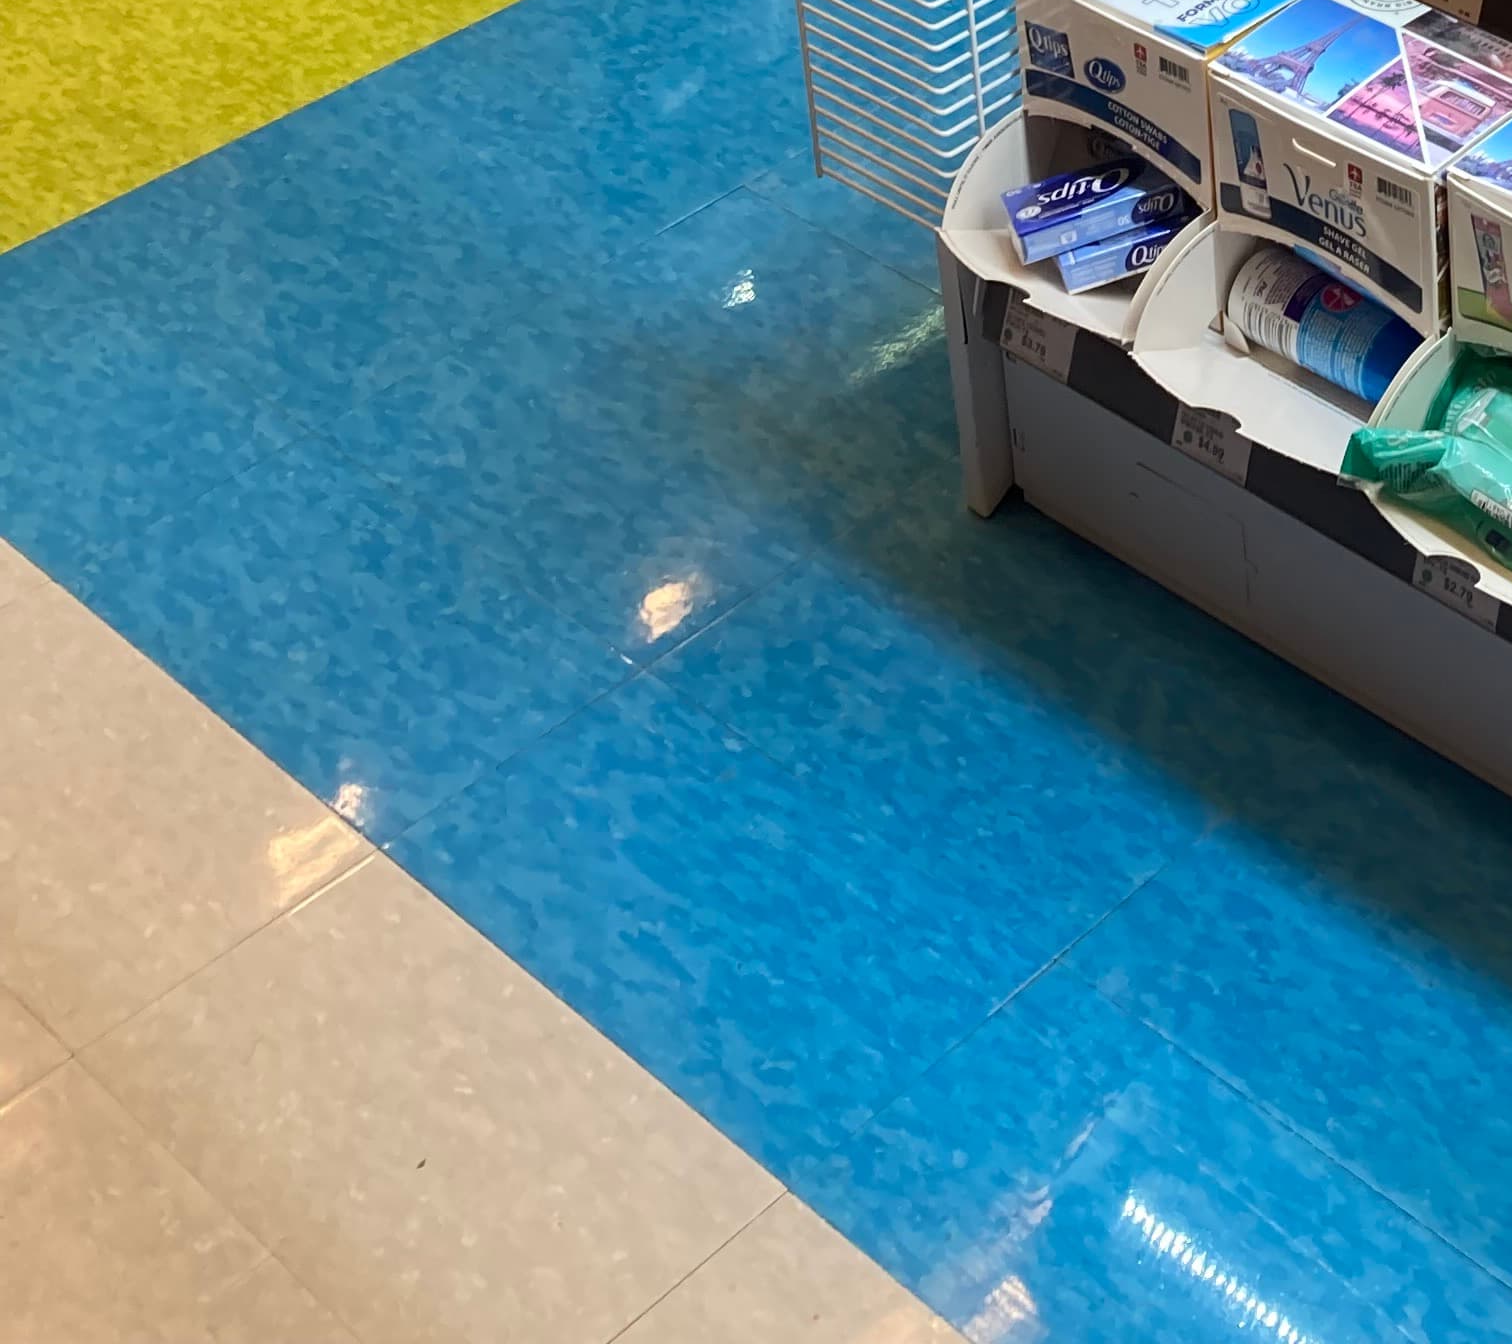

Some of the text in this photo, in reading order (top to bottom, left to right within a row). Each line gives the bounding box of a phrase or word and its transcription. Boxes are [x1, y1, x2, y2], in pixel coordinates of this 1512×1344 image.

[1108, 101, 1167, 143] COTTON SWABS
[1114, 116, 1160, 150] COTON-TIGE
[1283, 163, 1367, 237] Venus
[1318, 237, 1334, 251] GEL
[1343, 250, 1370, 274] RASER
[1323, 226, 1367, 259] SHAVE GEL
